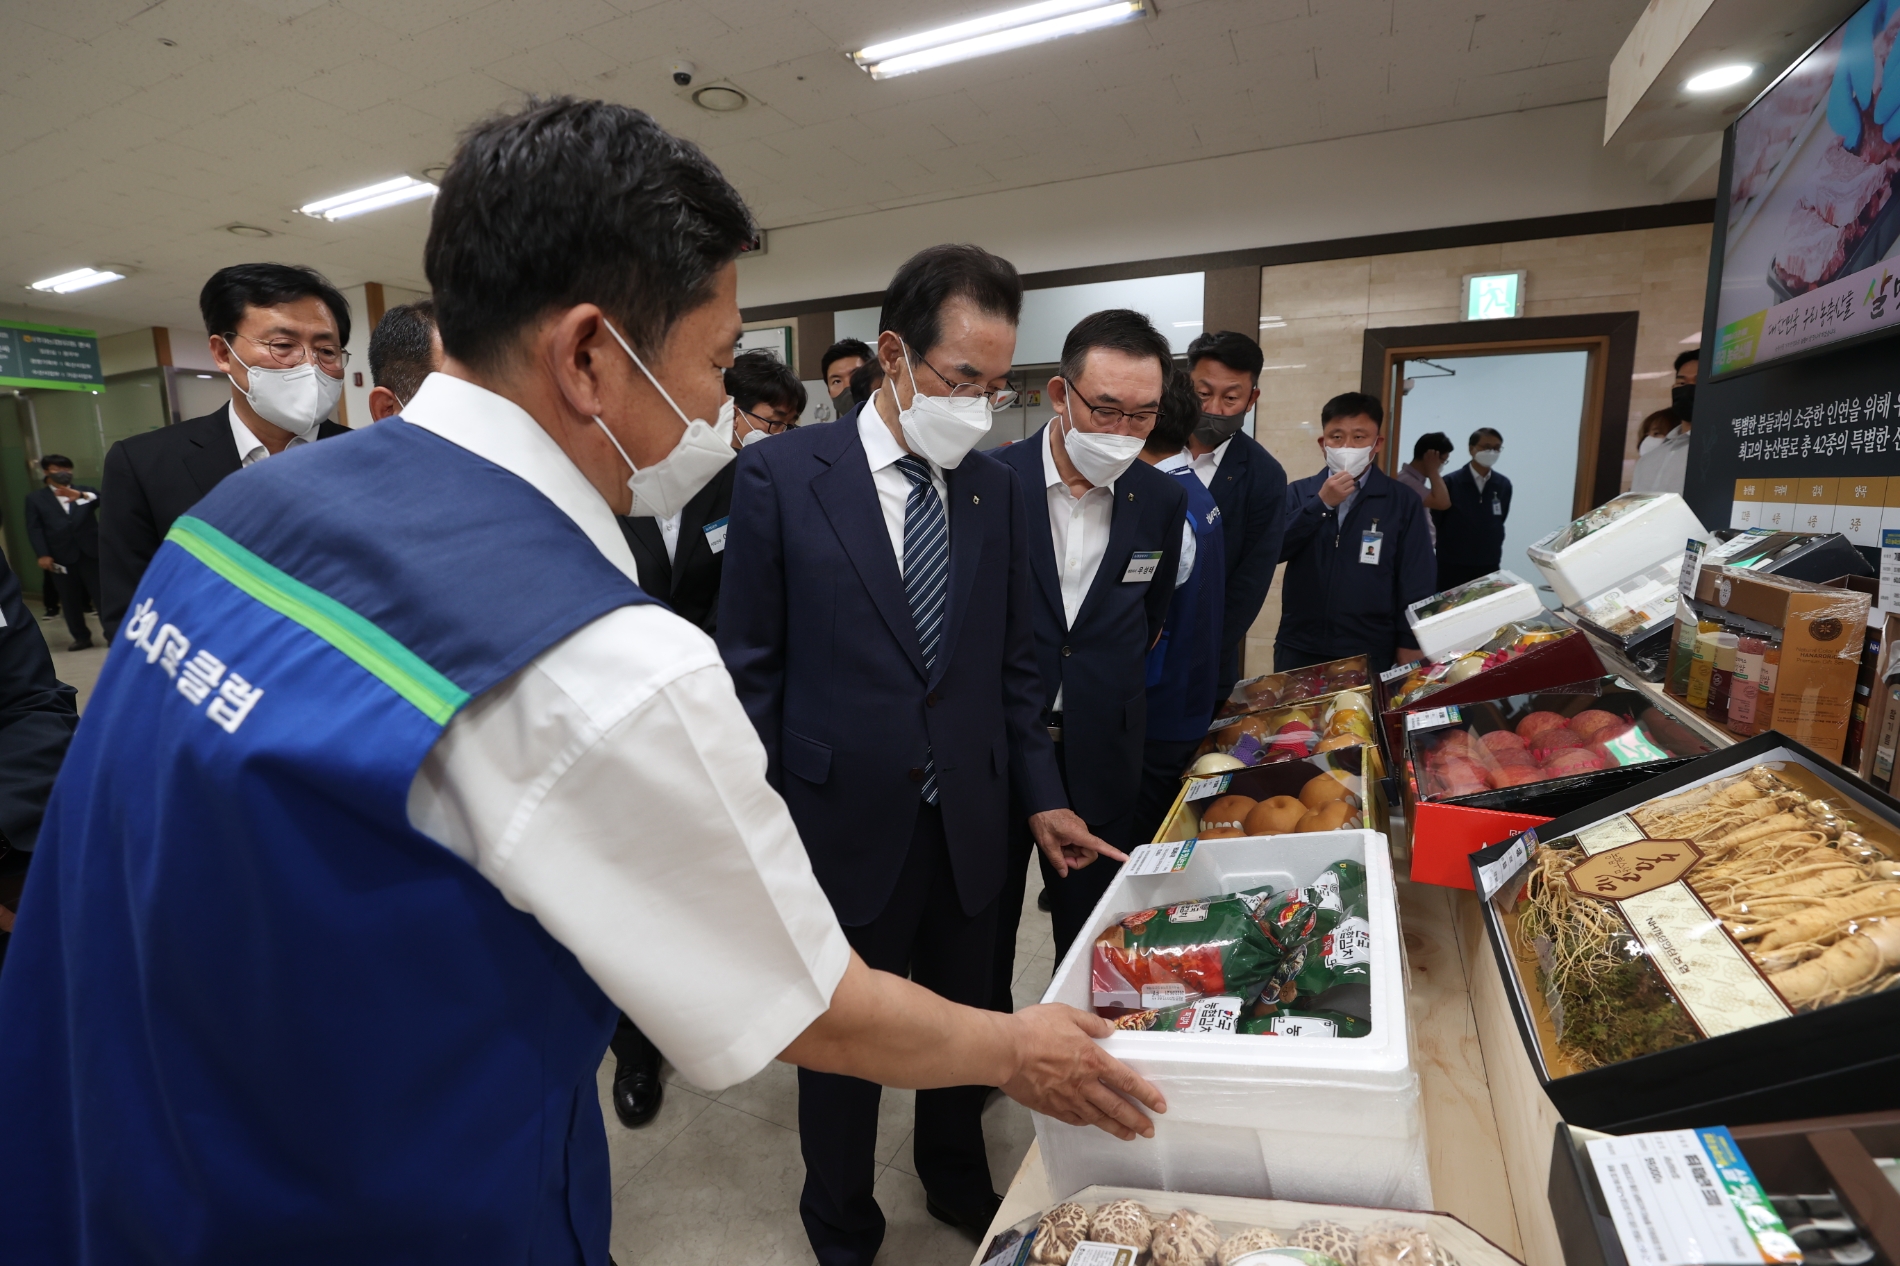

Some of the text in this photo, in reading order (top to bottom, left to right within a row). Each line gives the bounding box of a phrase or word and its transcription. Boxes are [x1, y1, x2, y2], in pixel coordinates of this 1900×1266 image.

[1757, 409, 1792, 435] 분들과의
[1793, 402, 1824, 427] 소중한
[1827, 397, 1862, 426] 인연을
[1864, 391, 1891, 421] 위해
[1738, 439, 1763, 463] 최고의
[1764, 437, 1799, 460] 농산물로
[1800, 434, 1811, 458] 총
[1812, 429, 1848, 457] 42종의
[1851, 425, 1890, 455] 특별한
[1812, 485, 1823, 497] 김치
[1855, 485, 1867, 498] 양곡
[1807, 515, 1818, 528] 4종
[1849, 518, 1861, 532] 3종
[1869, 642, 1879, 652] NH
[125, 597, 265, 734] 하나로클럽
[1215, 1009, 1234, 1031] 한국
